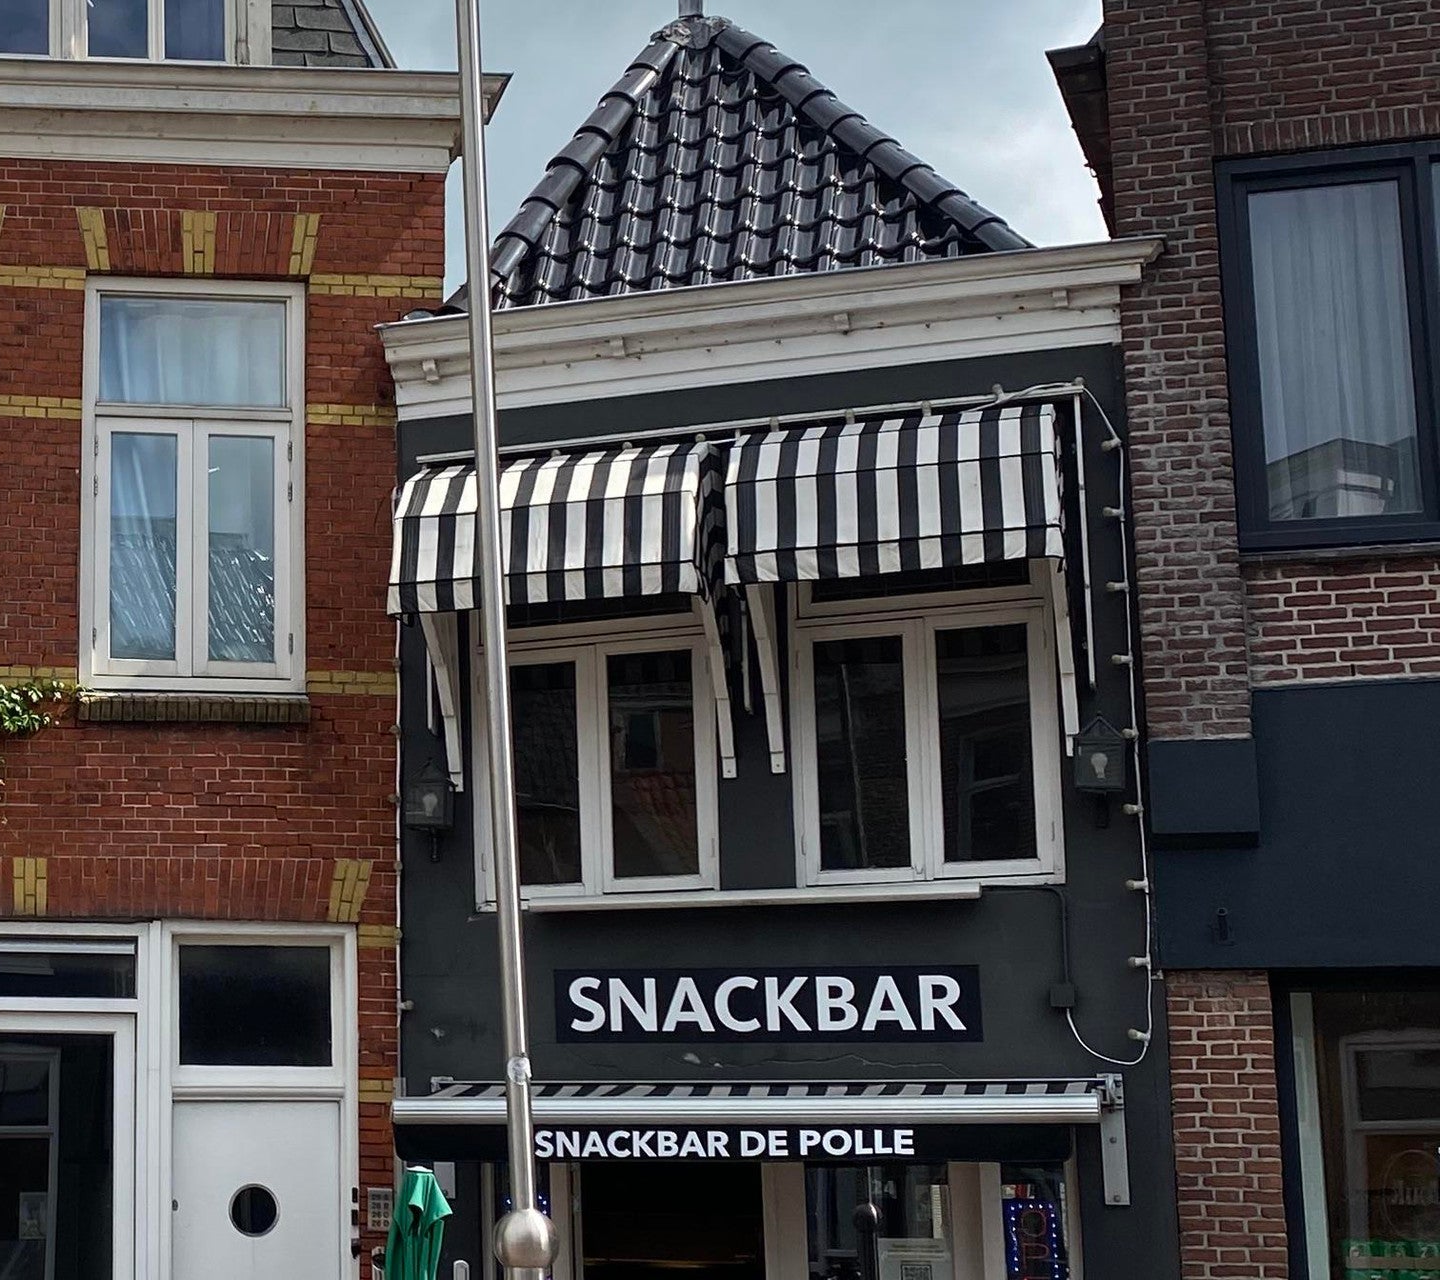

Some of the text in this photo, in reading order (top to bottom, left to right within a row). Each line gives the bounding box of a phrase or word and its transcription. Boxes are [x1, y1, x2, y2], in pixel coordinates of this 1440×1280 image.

[568, 974, 967, 1033] SNACKBAR
[534, 1128, 915, 1158] SNACKBAR DE POLLE
